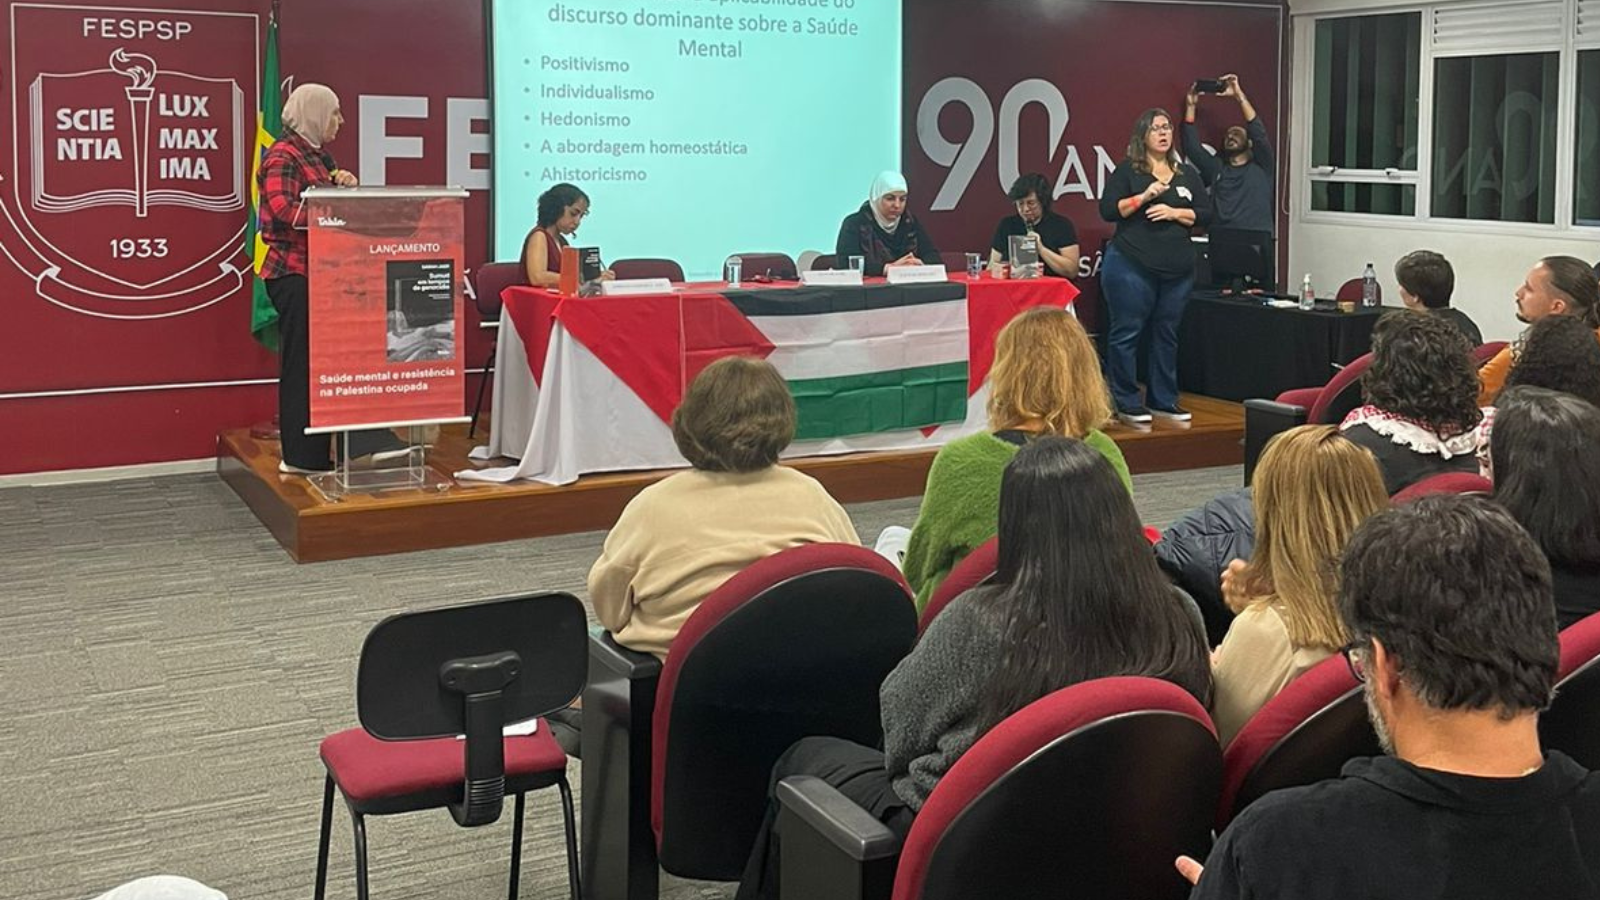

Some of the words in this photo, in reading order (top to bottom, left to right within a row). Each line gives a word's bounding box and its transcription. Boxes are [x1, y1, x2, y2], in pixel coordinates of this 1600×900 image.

[83, 18, 192, 40] FESPSP
[547, 3, 628, 25] discurso
[633, 8, 732, 30] dominante
[738, 14, 788, 33] sobre
[792, 20, 802, 33] a
[806, 16, 859, 36] Saúde
[678, 39, 743, 58] Mental
[540, 55, 630, 73] Positivismo
[540, 84, 655, 101] Individualismo
[159, 93, 210, 117] LUX
[56, 108, 115, 131] SCIE
[540, 111, 631, 127] Hedonismo
[159, 128, 219, 150] MAX
[540, 139, 552, 154] A
[556, 139, 646, 158] abordagem
[650, 139, 748, 155] homeostática
[916, 77, 1070, 212] 90
[57, 137, 123, 161] NTIA
[159, 157, 211, 180] IMA
[540, 167, 647, 182] Ahistoricismo
[110, 238, 169, 258] 1933
[369, 243, 441, 255] LANÇAMENTO
[319, 374, 353, 384] Saúde
[354, 371, 391, 382] mental
[392, 372, 399, 380] e
[401, 367, 456, 379] resistência
[319, 388, 333, 397] na
[335, 384, 383, 396] Palestina
[385, 381, 429, 393] ocupada
